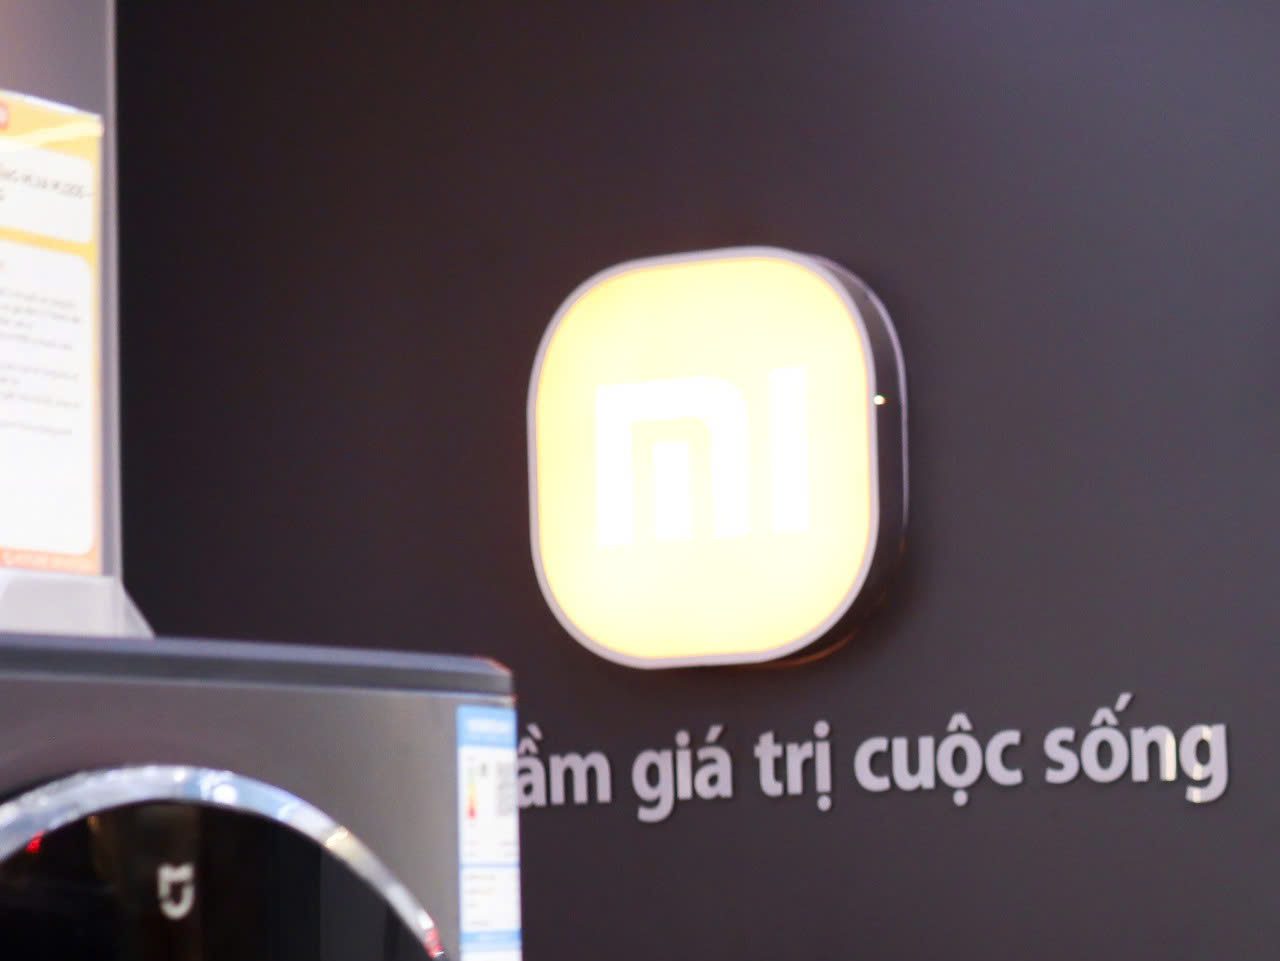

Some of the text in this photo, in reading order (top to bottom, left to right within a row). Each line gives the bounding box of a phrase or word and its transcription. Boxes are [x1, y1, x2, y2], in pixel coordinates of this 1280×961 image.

[517, 692, 1229, 823] ầm giá trị cuộc sống
